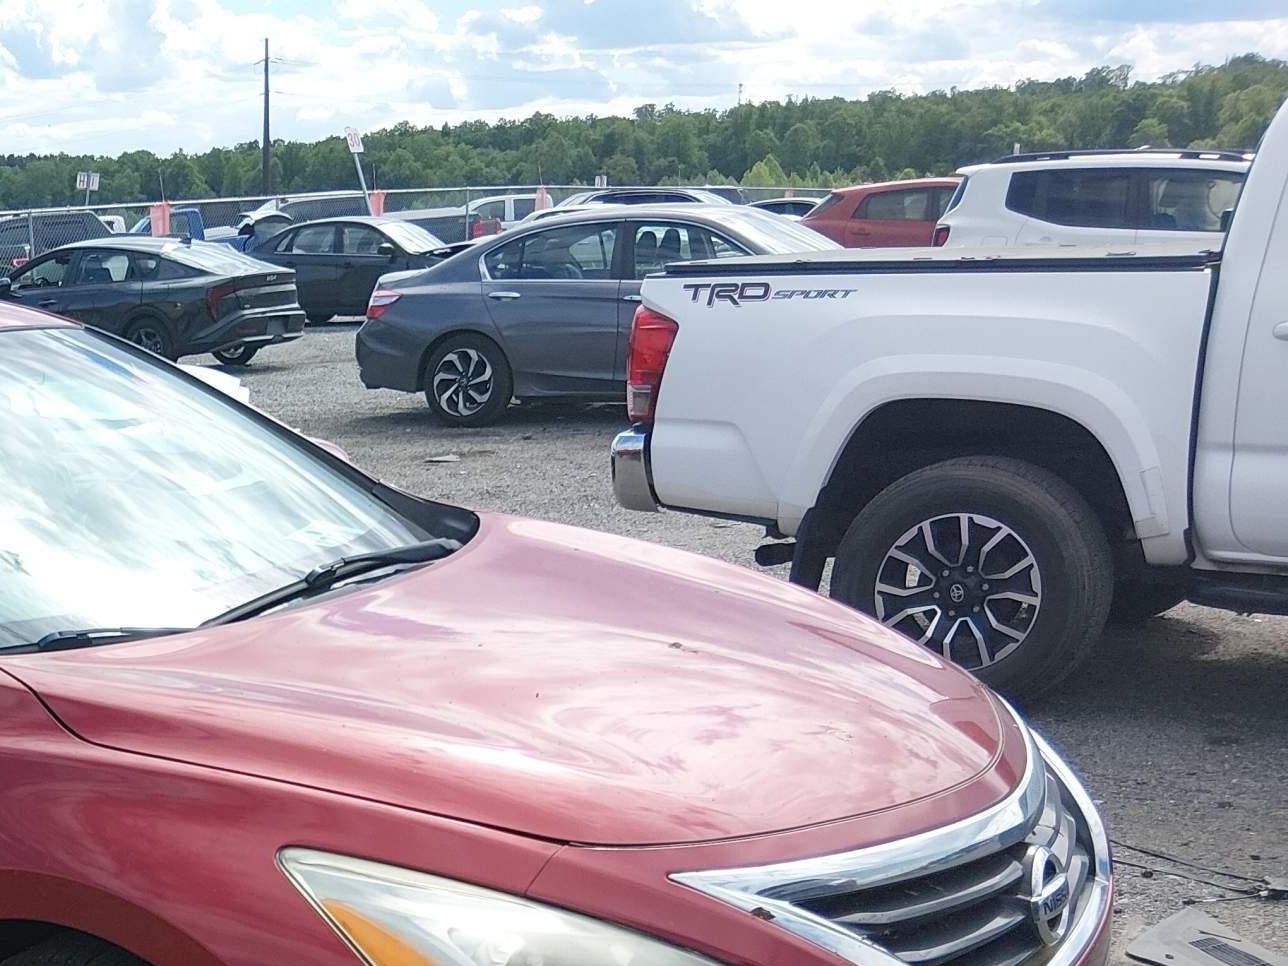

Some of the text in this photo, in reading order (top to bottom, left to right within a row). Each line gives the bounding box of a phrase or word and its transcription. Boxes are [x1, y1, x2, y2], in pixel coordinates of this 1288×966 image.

[347, 132, 361, 147] 30
[683, 282, 859, 308] TRD SPORT
